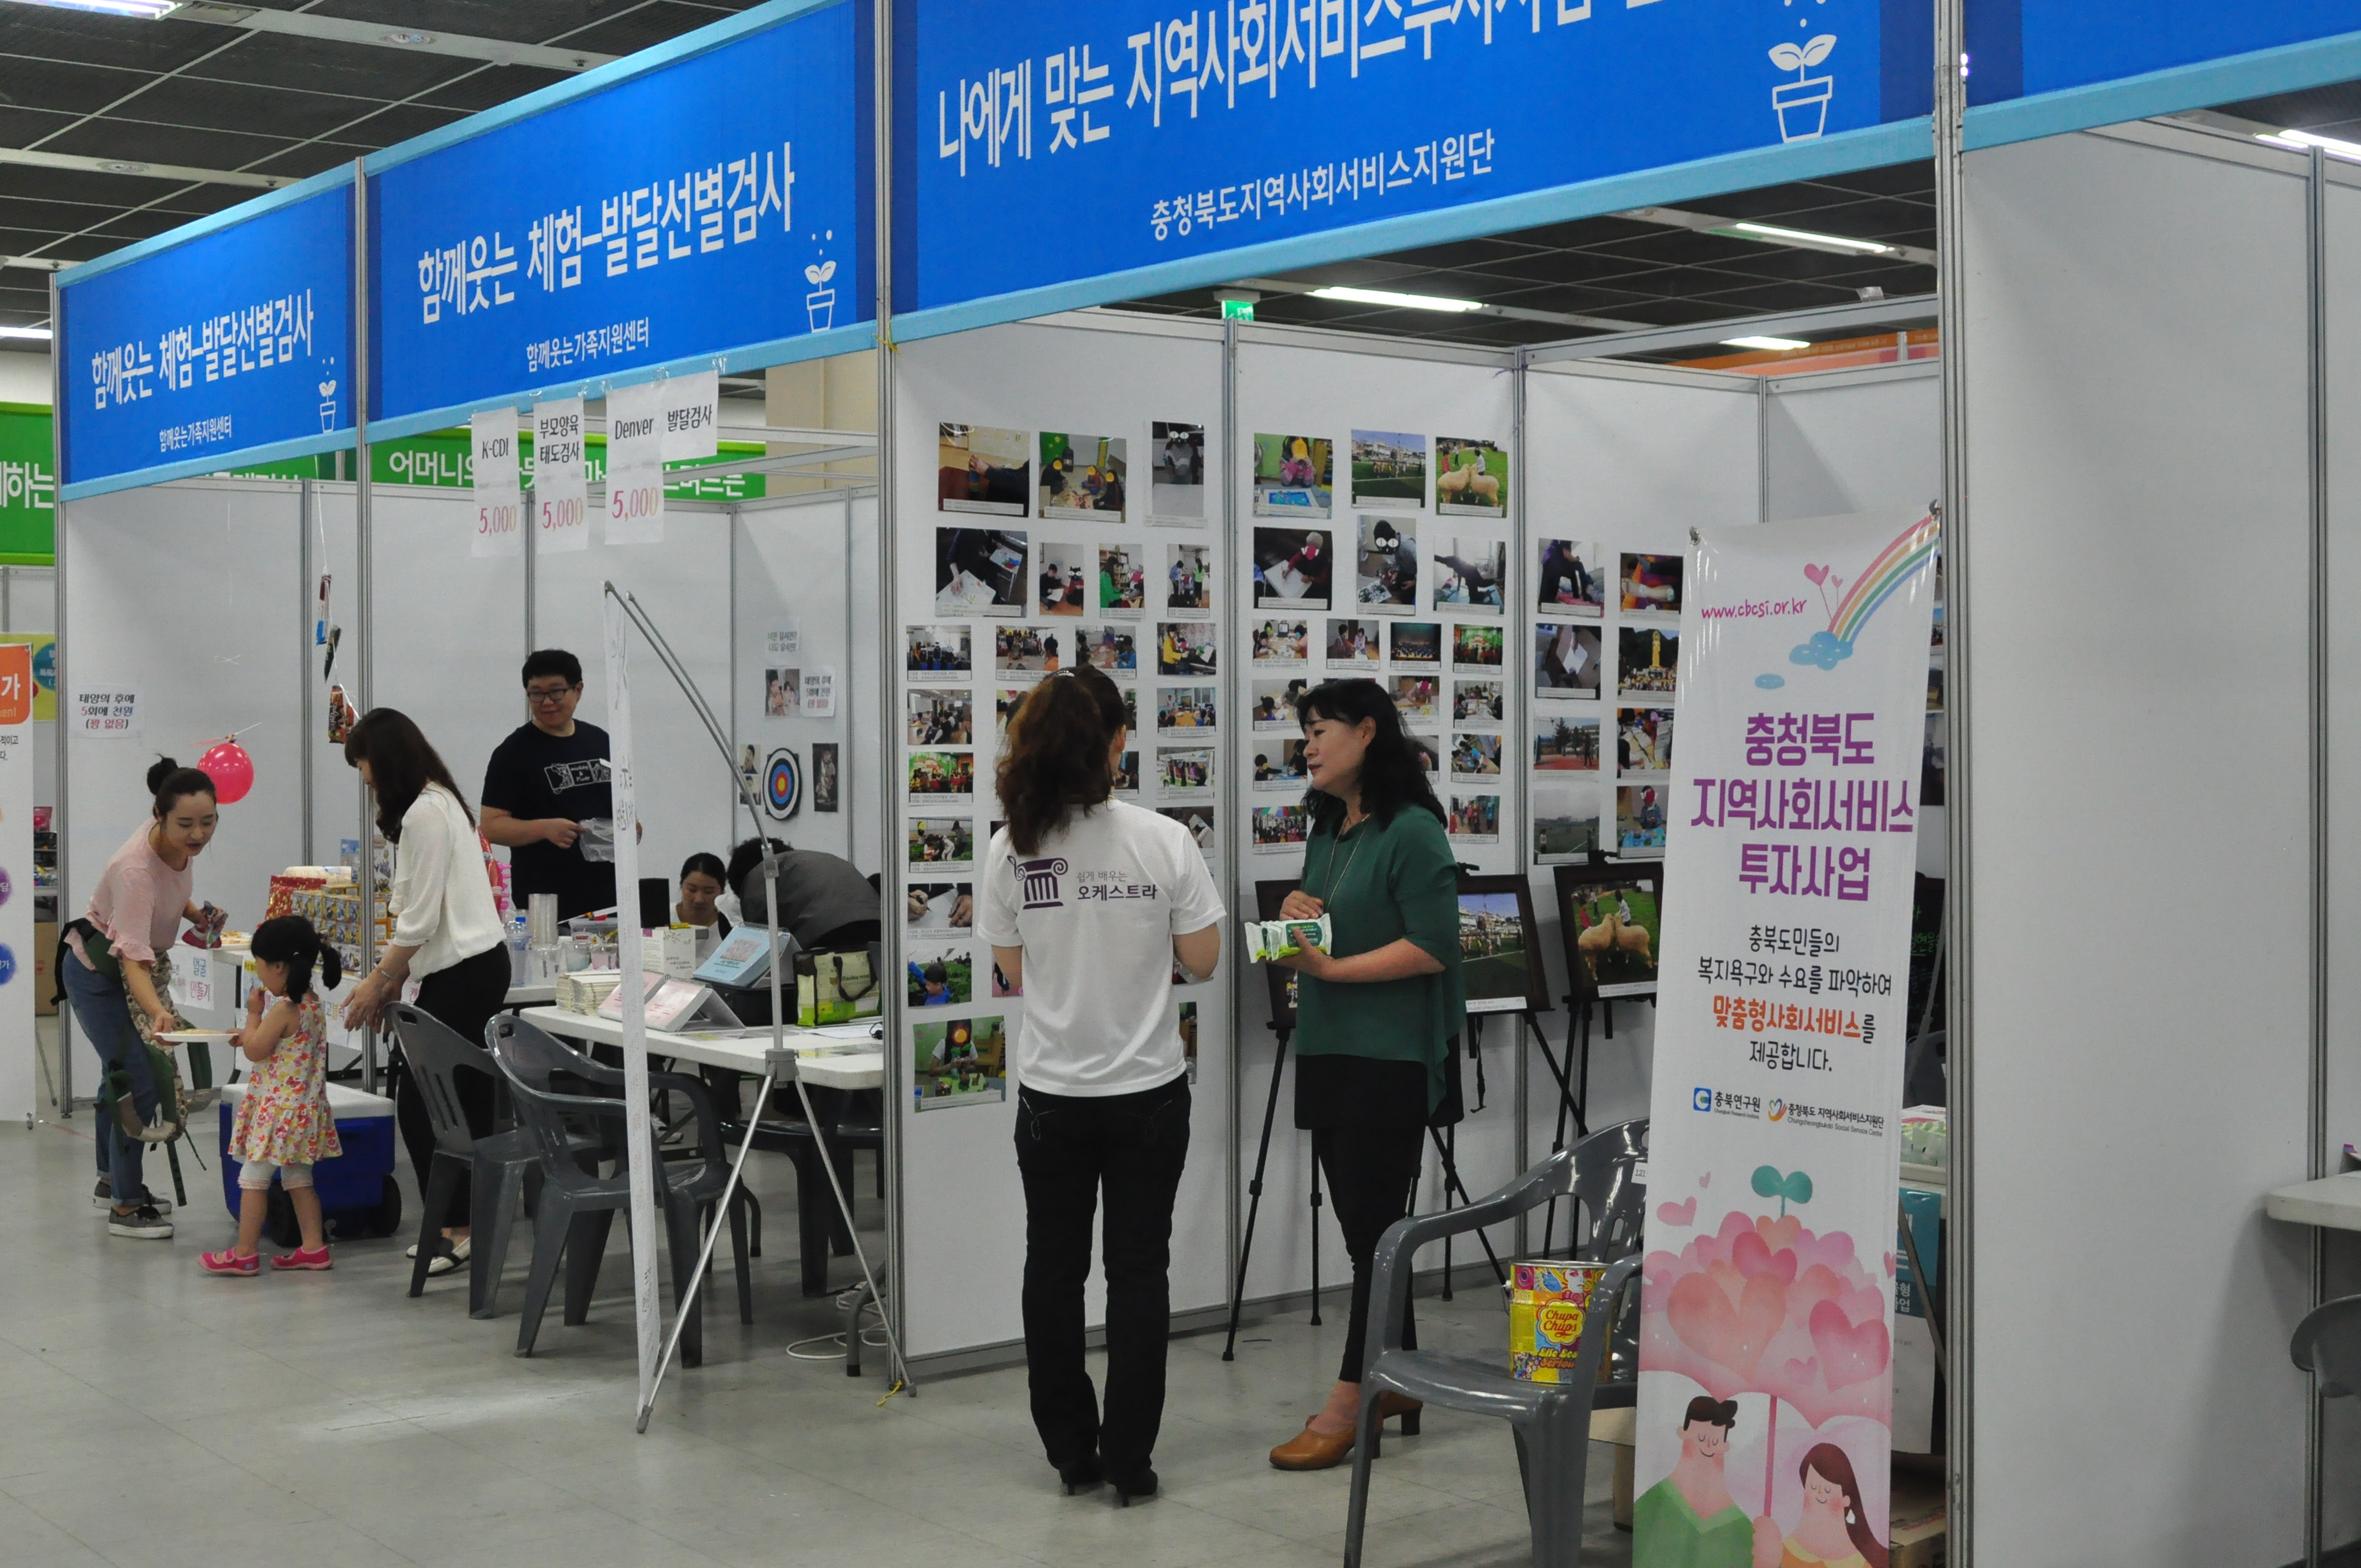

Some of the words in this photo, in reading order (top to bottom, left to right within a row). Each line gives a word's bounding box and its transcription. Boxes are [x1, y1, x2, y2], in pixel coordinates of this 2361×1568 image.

[939, 58, 1031, 177] 나에게
[1046, 45, 1114, 154] 맞는
[1151, 128, 1495, 241] 충청북도지역사회서비스지원단
[418, 231, 517, 324] 함께웃는
[526, 317, 649, 373] 함께웃는가족지원센터
[92, 340, 153, 409] 함께웃는
[159, 414, 232, 453] 함께웃는가족지원센터
[539, 414, 579, 436] 부모양육
[614, 416, 654, 440] Denver
[667, 404, 712, 432] 발달검사
[482, 438, 509, 459] K-CDI
[540, 445, 580, 464] 태도검사
[0, 461, 54, 508] 하는
[542, 497, 583, 531] 5,000
[612, 487, 658, 519] 5,000
[478, 505, 517, 536] 5,000
[1701, 597, 1807, 619] www.cbcsi.or.kr
[79, 694, 110, 704] 태양의
[114, 693, 135, 704] 후예
[81, 706, 108, 716] 5회에
[113, 706, 133, 716] 천원
[1745, 712, 1874, 766] 충청북도
[1691, 778, 1913, 832] 지역사회서비스
[1076, 872, 1095, 883] 쉽게
[1098, 870, 1127, 882] 배우는
[1739, 843, 1870, 901] 투자사업
[1078, 884, 1157, 901] 오케스트라
[1749, 924, 1839, 957] 충북도민들의
[1698, 956, 1774, 985] 복지욕구와
[1778, 965, 1823, 994] 수요를
[1828, 968, 1891, 998] 파악하여
[1713, 995, 1876, 1044] 맞춤형사회서비스를
[1749, 1040, 1832, 1071] 제공합니다.
[1714, 1091, 1761, 1113] 충북연구원
[1788, 1103, 1816, 1117] 충청북도
[1818, 1107, 1884, 1129] 지역사회서비스지원단
[1543, 1320, 1577, 1337] Chups
[1546, 1310, 1579, 1322] Chupa
